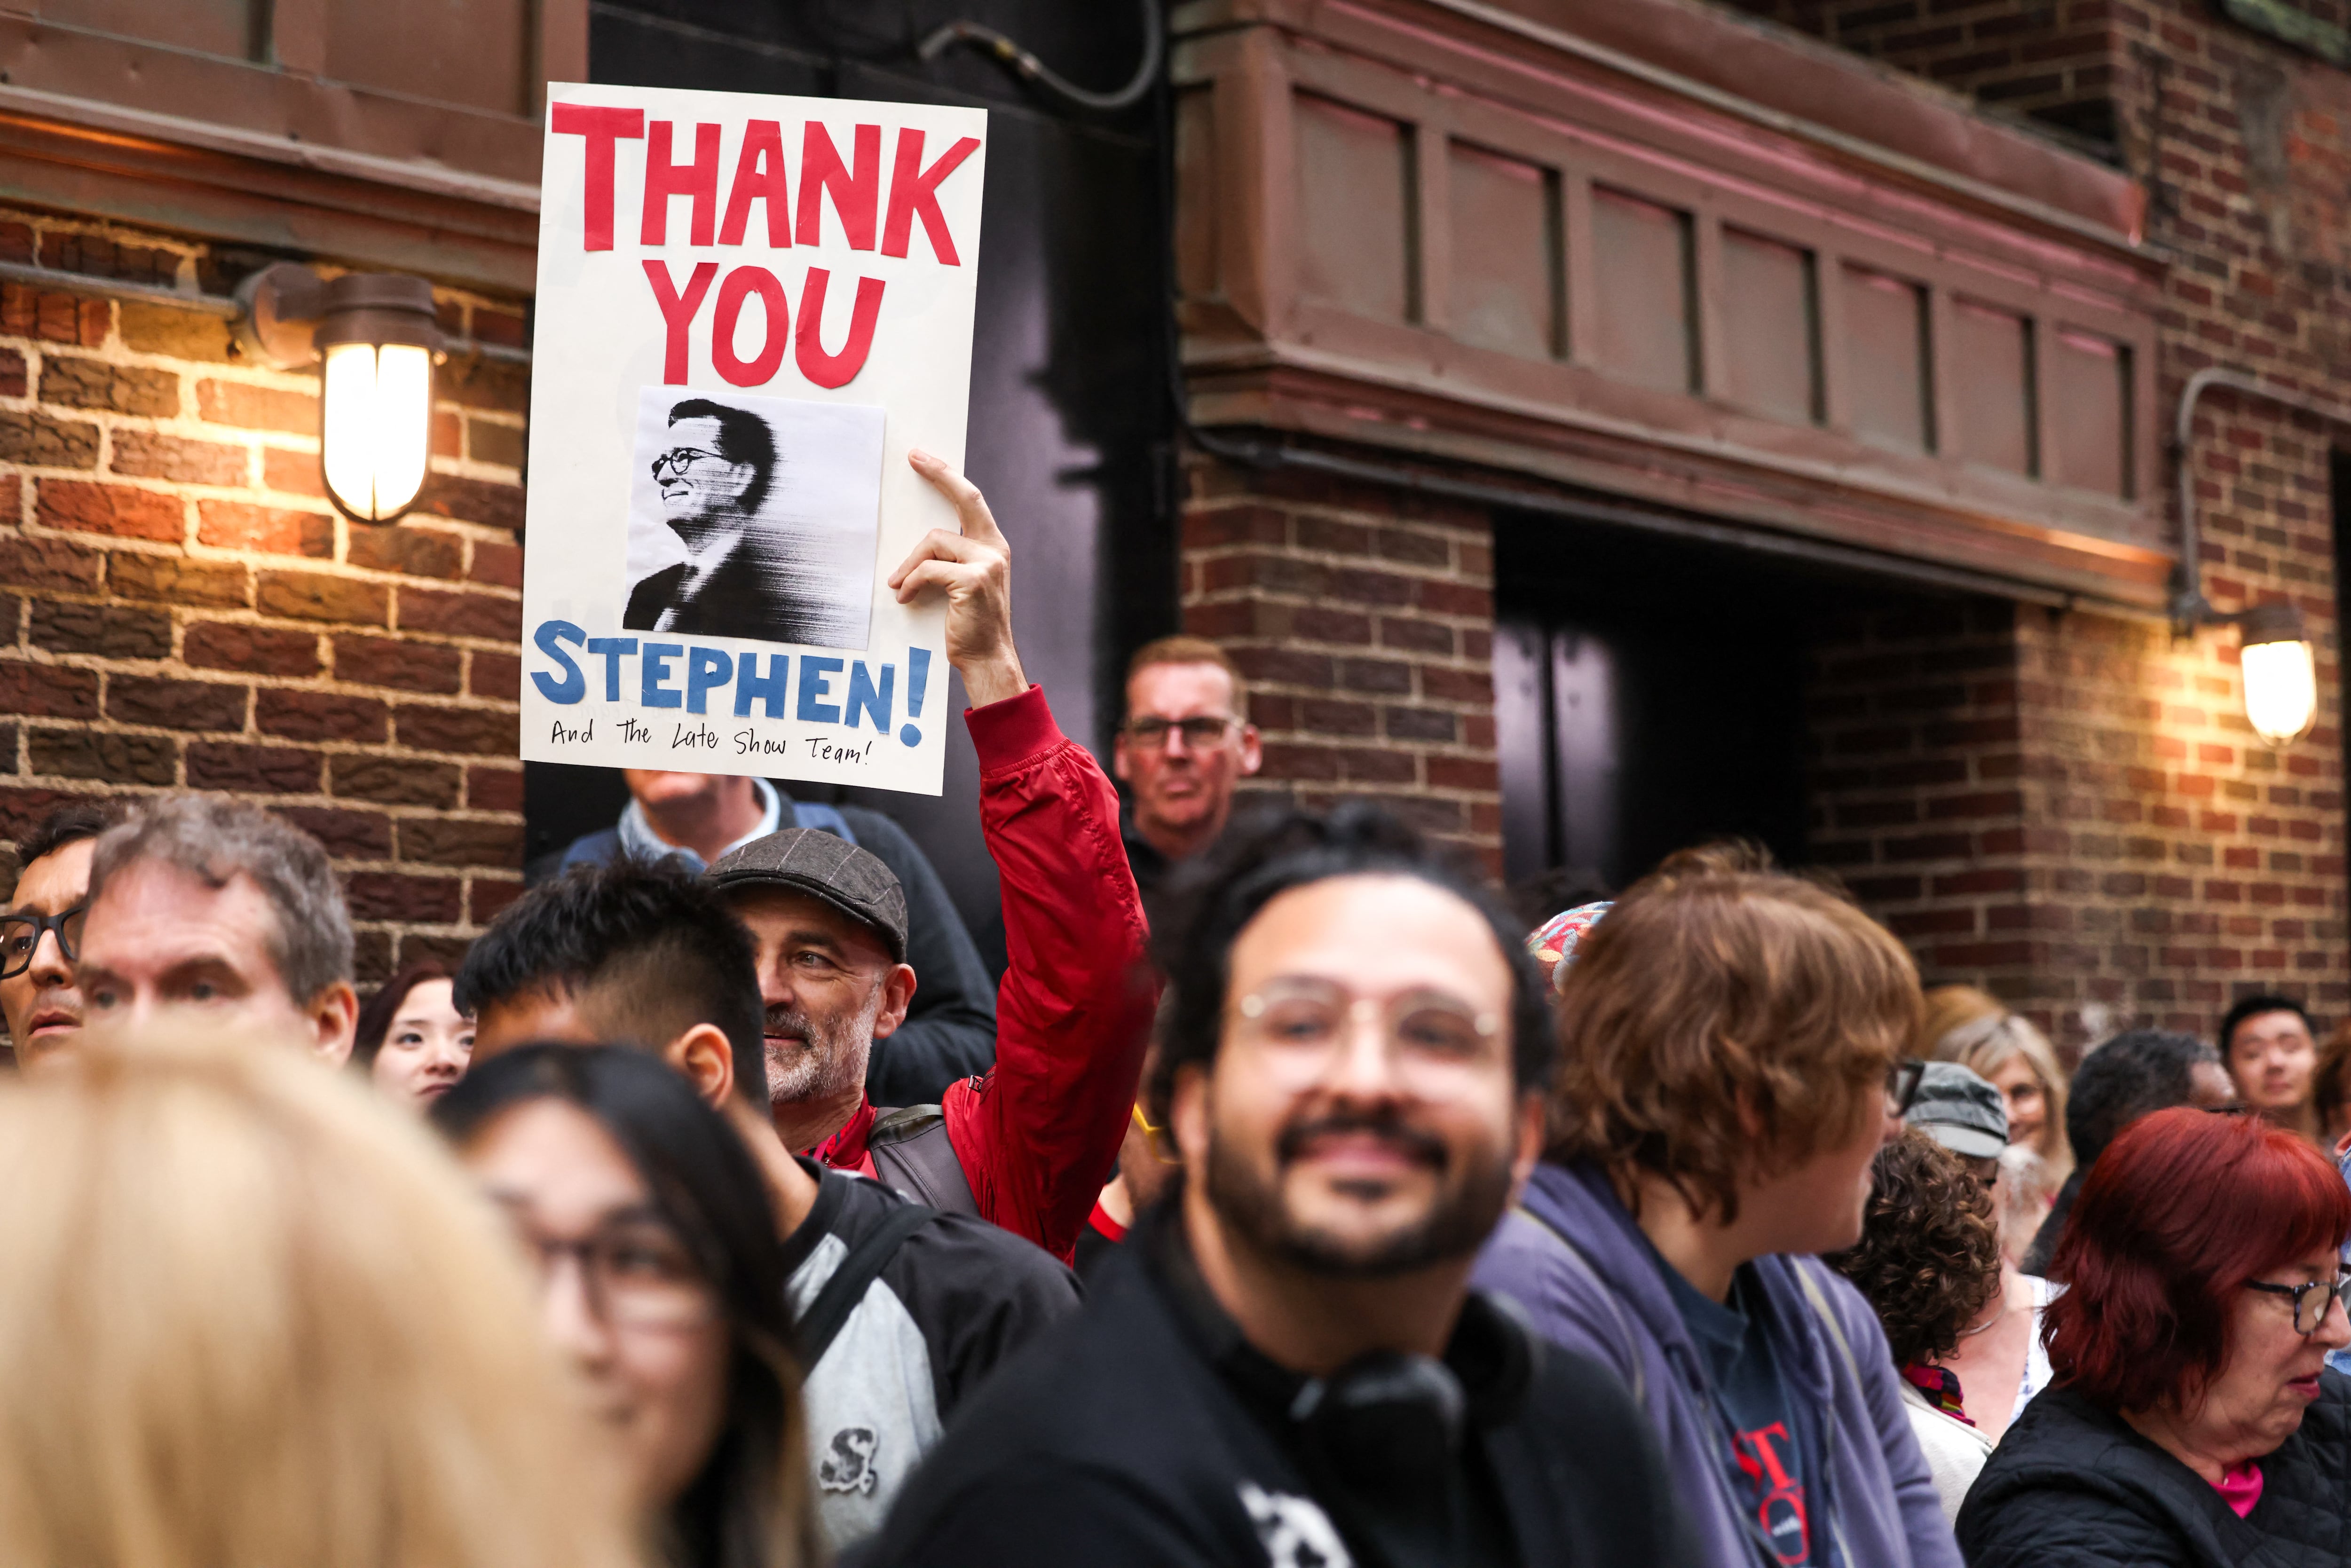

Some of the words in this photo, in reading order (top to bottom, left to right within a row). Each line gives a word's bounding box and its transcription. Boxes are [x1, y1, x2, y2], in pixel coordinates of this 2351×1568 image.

[552, 102, 981, 267] THANK
[641, 260, 886, 389] YOU
[530, 620, 931, 748] STEPHEN!
[550, 717, 593, 745] And
[615, 717, 652, 744] The
[671, 722, 719, 749] Late
[734, 727, 786, 755] Show
[805, 737, 873, 765] Team!
